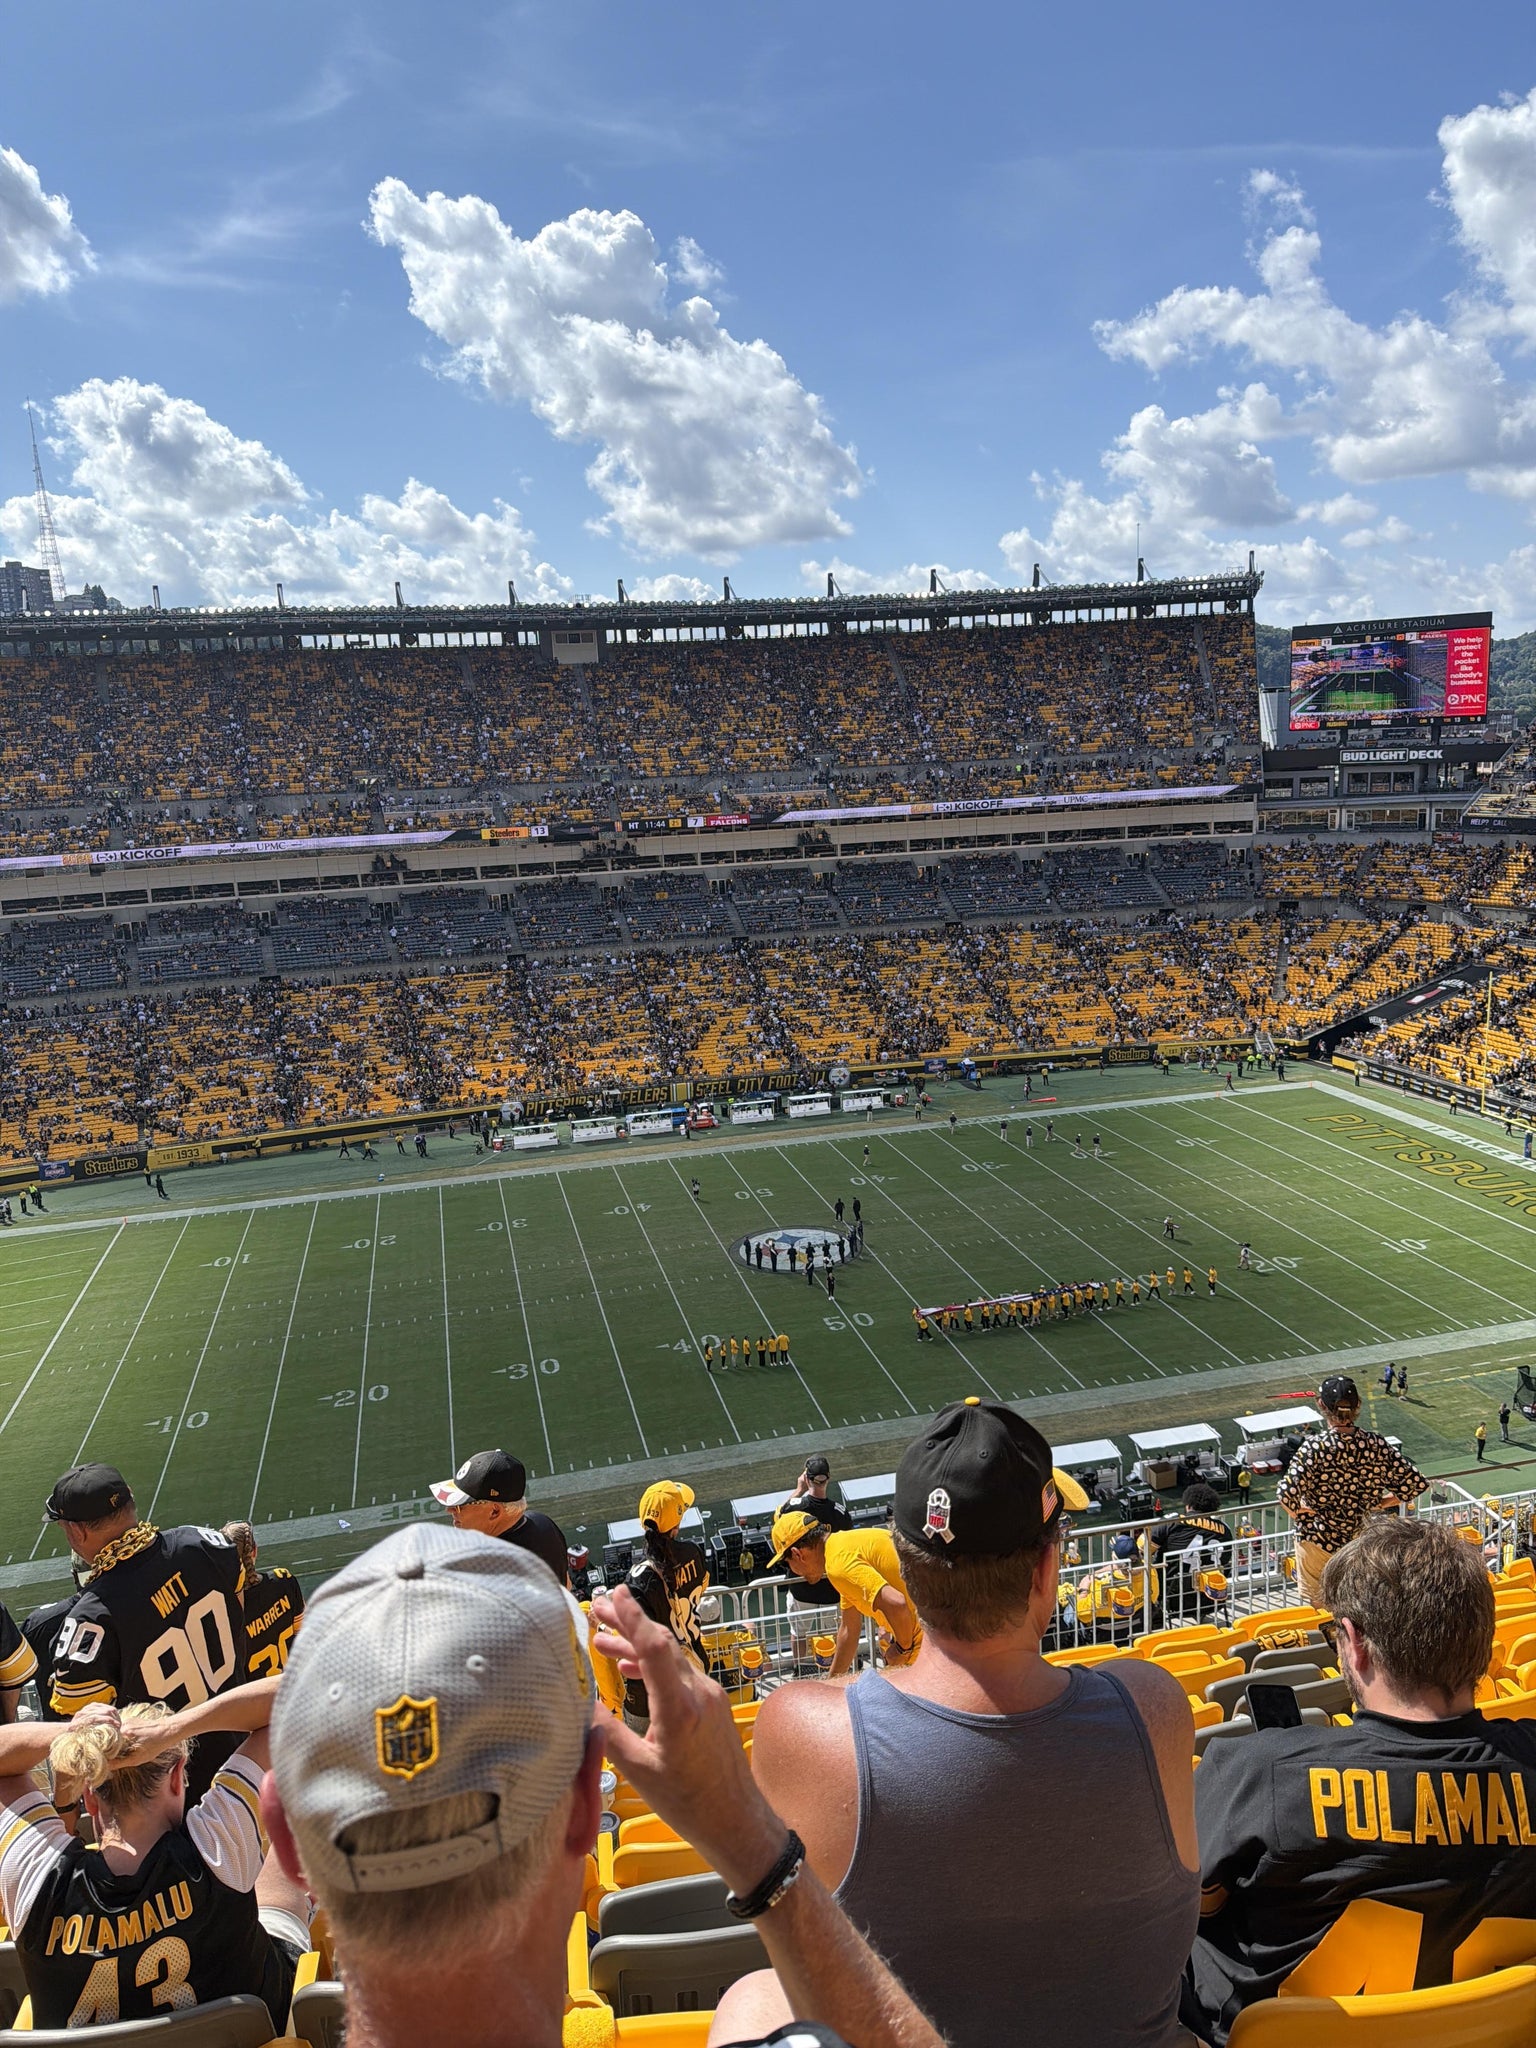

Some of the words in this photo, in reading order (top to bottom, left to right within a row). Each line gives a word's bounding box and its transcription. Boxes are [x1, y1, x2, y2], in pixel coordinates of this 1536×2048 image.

[1346, 622, 1398, 632] ACRISURE
[1402, 618, 1446, 628] STADIUM
[1454, 644, 1482, 653] protect
[1454, 657, 1480, 666] pocket
[1450, 671, 1483, 679] nobody's
[1461, 694, 1485, 703] PNC
[1342, 751, 1368, 761] BUD
[1369, 750, 1405, 760] LIGHT
[1409, 749, 1443, 759] DECK
[954, 800, 1003, 811] KICKOFF
[1063, 795, 1089, 803] UPMC
[628, 822, 640, 830] HT
[645, 820, 665, 829] 11:44
[692, 818, 698, 826] 7
[710, 818, 748, 826] FALCONS
[1470, 818, 1490, 826] HELP?
[490, 829, 520, 838] Steelers
[534, 827, 546, 835] 13
[256, 841, 287, 851] UPMC
[120, 847, 182, 861] KICKOFF
[1108, 1048, 1150, 1062] Steelers
[696, 1080, 732, 1097] STEEL
[737, 1076, 764, 1093] CITY
[1422, 1124, 1448, 1132] IT
[1448, 1134, 1511, 1156] TAKES
[176, 1148, 200, 1159] 1933
[84, 1156, 138, 1176] Steelers
[961, 1161, 1000, 1172] 30
[1304, 1114, 1536, 1214] PITTSBUR
[850, 1174, 885, 1186] 40
[734, 1188, 774, 1200] 50
[613, 1202, 651, 1215] 40
[487, 1218, 528, 1231] 30
[354, 1234, 396, 1249] 20
[1381, 1238, 1427, 1253] 10
[213, 1253, 252, 1267] 10
[822, 1312, 874, 1331] 50
[673, 1333, 722, 1354] 40
[508, 1358, 560, 1380] 30
[333, 1384, 390, 1408] 20
[158, 1410, 210, 1434] 10
[1179, 1513, 1225, 1535] POLAMALU
[150, 1570, 190, 1621] WATT
[245, 1594, 292, 1639] WARREN
[55, 1615, 106, 1664] 90
[139, 1588, 237, 1712] 90
[1308, 1767, 1536, 1846] POLAMAL
[45, 1880, 194, 1957] POLAMALU
[66, 1936, 199, 2028] 43
